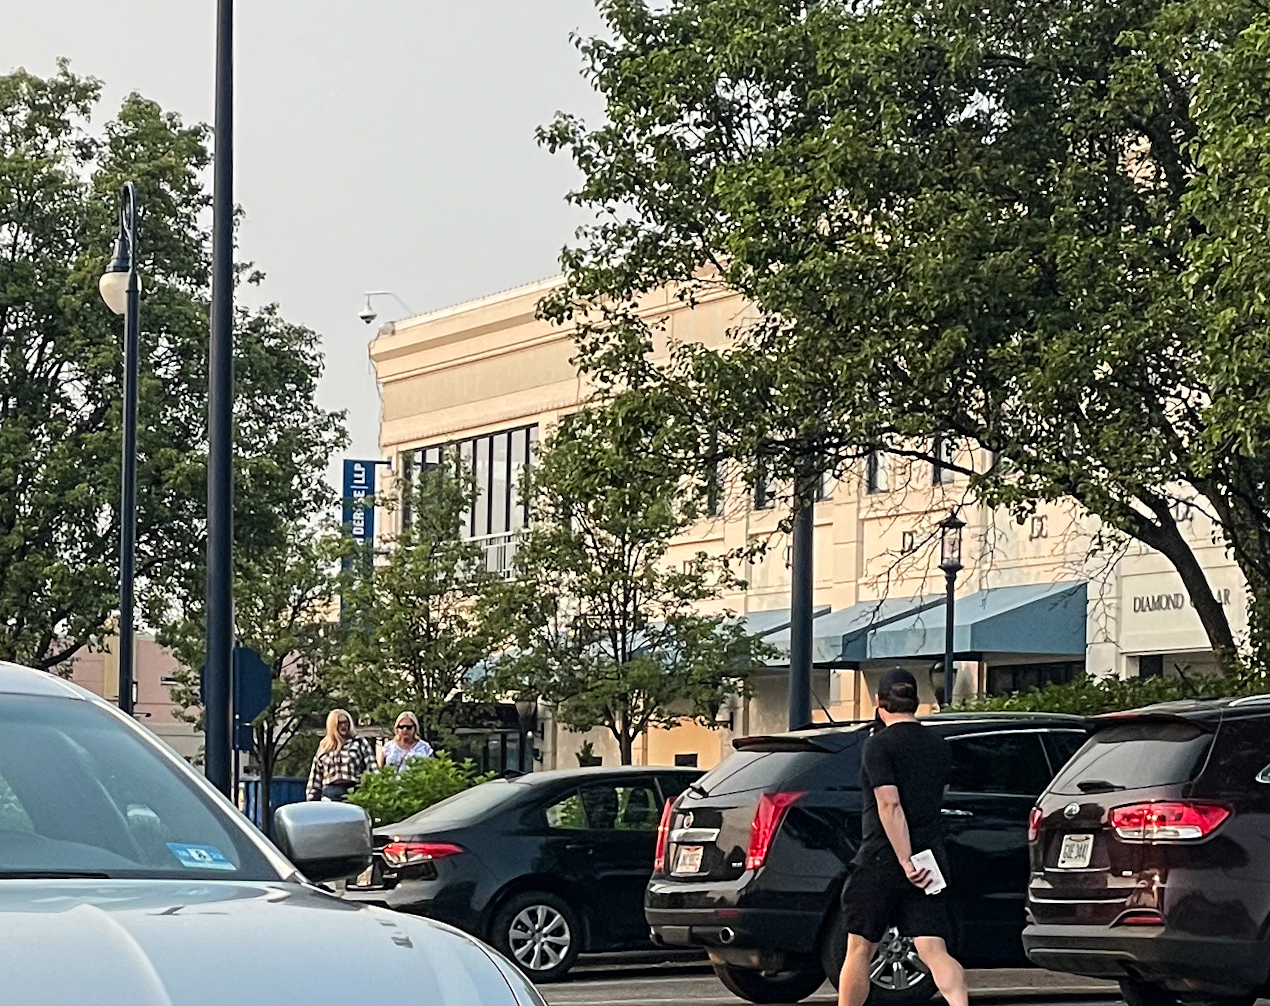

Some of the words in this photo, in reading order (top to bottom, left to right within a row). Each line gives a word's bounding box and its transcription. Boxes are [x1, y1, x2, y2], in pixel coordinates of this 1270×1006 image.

[353, 462, 366, 484] LLP
[352, 489, 366, 536] DERE
[1133, 592, 1185, 613] DIAMOND
